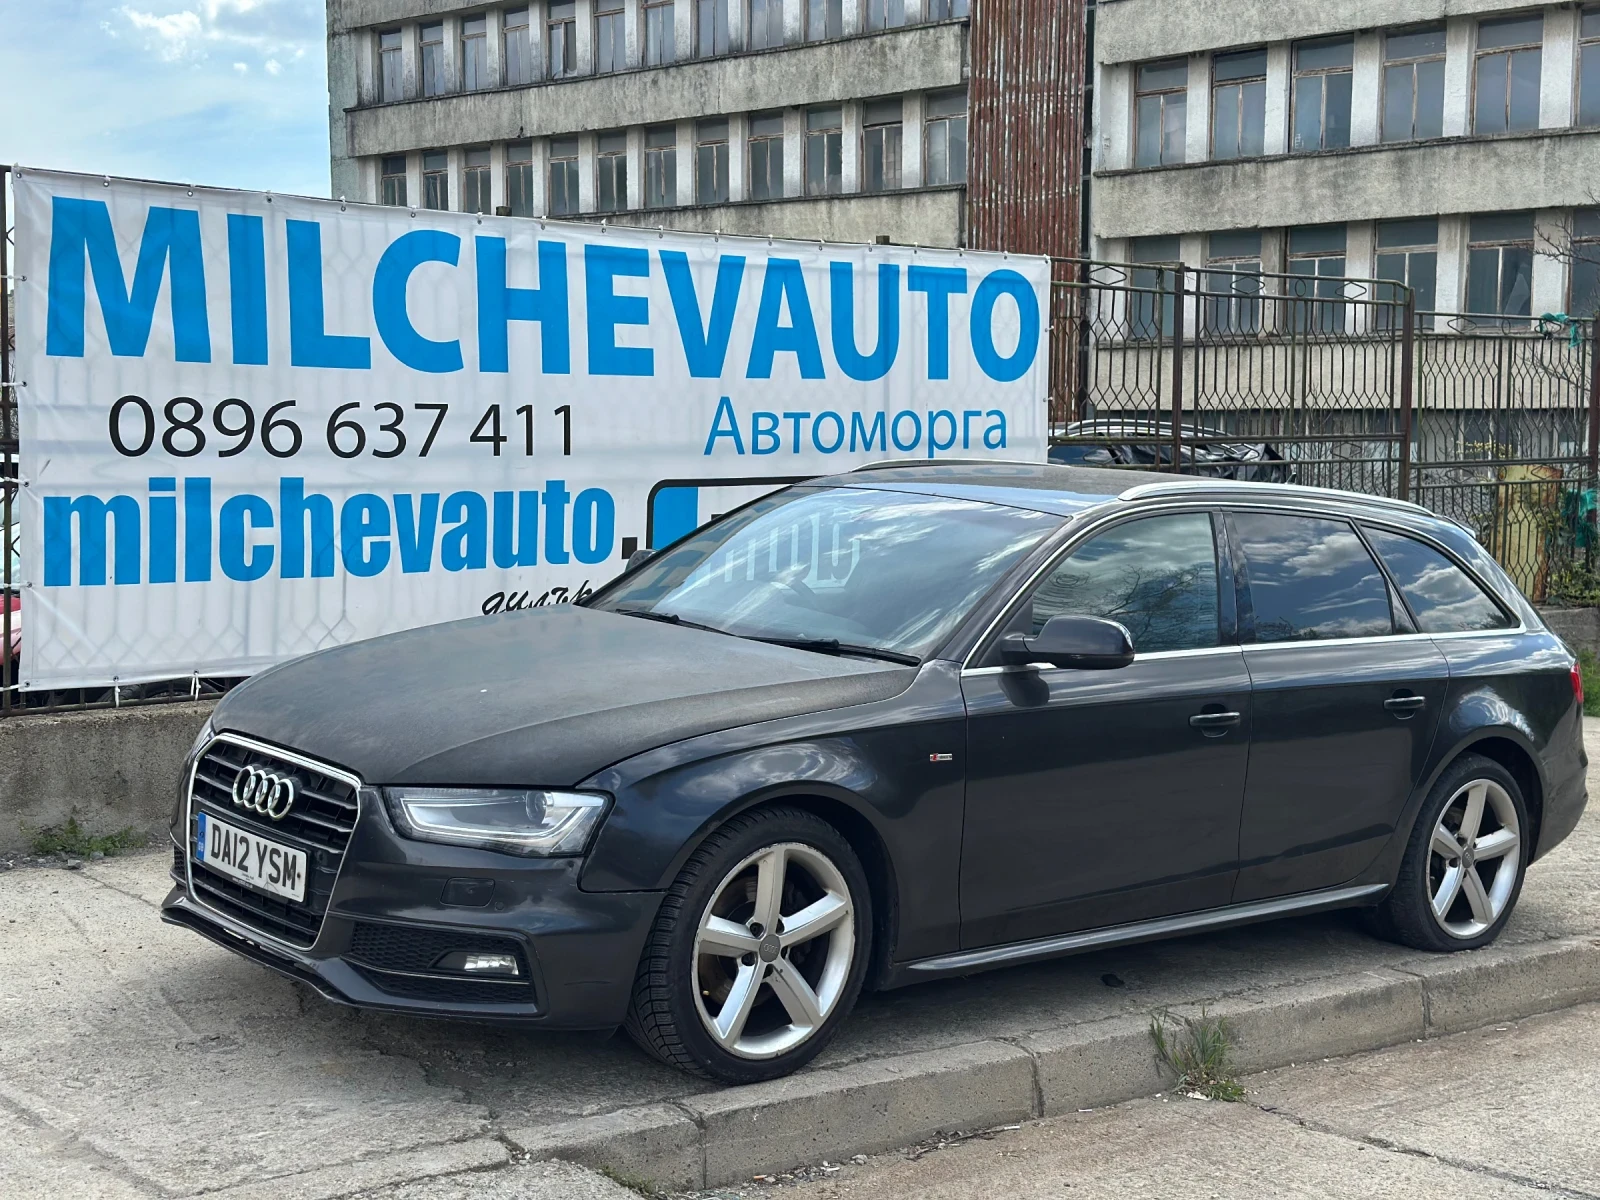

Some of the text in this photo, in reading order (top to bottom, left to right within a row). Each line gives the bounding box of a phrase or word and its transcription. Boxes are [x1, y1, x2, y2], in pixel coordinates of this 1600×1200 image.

[46, 196, 1040, 382] MILCHEVAUTO
[109, 396, 571, 459] 0896 637 411
[704, 396, 1007, 459] Автоморга
[211, 823, 297, 891] DA12 YSM
